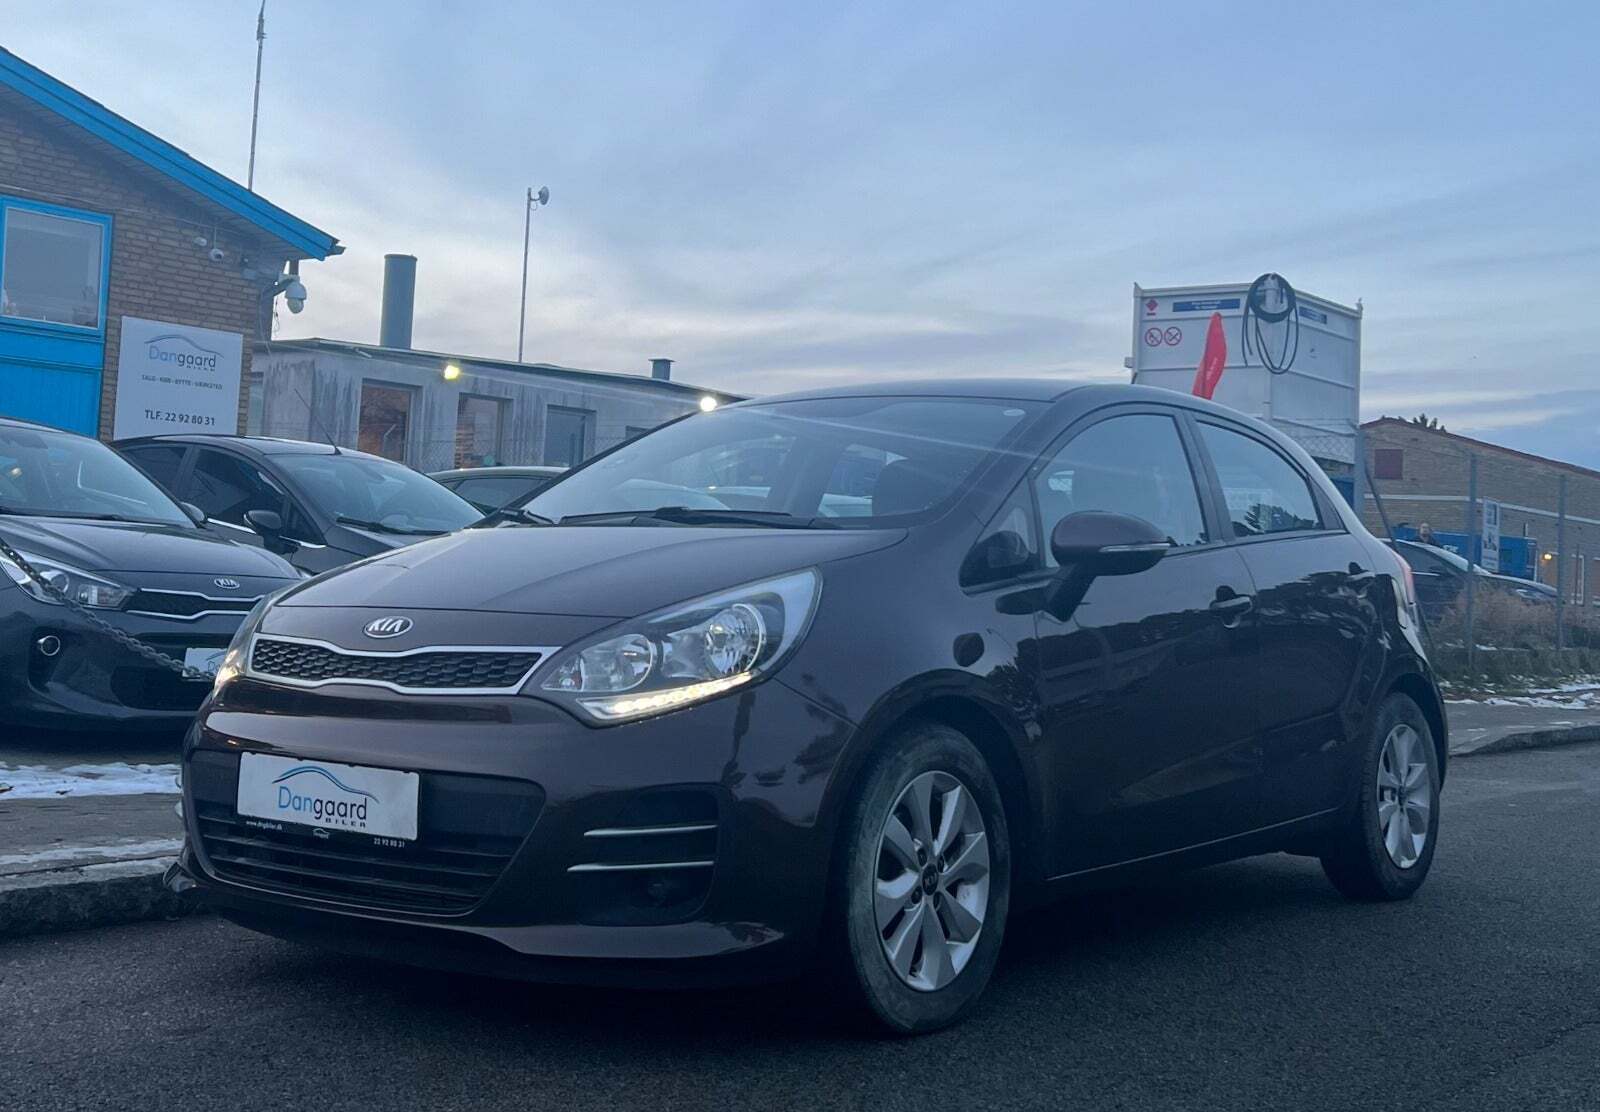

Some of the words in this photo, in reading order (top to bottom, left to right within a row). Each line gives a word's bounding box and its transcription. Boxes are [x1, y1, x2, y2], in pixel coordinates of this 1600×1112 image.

[149, 345, 216, 367] Dangaard
[144, 409, 163, 421] TLF.
[165, 412, 176, 422] 22
[179, 413, 190, 423] 92
[191, 414, 203, 424] 80
[204, 415, 215, 425] 31
[218, 578, 237, 587] KIA
[368, 617, 404, 632] KIA
[279, 786, 367, 820] Dangaard
[325, 817, 366, 828] BILER
